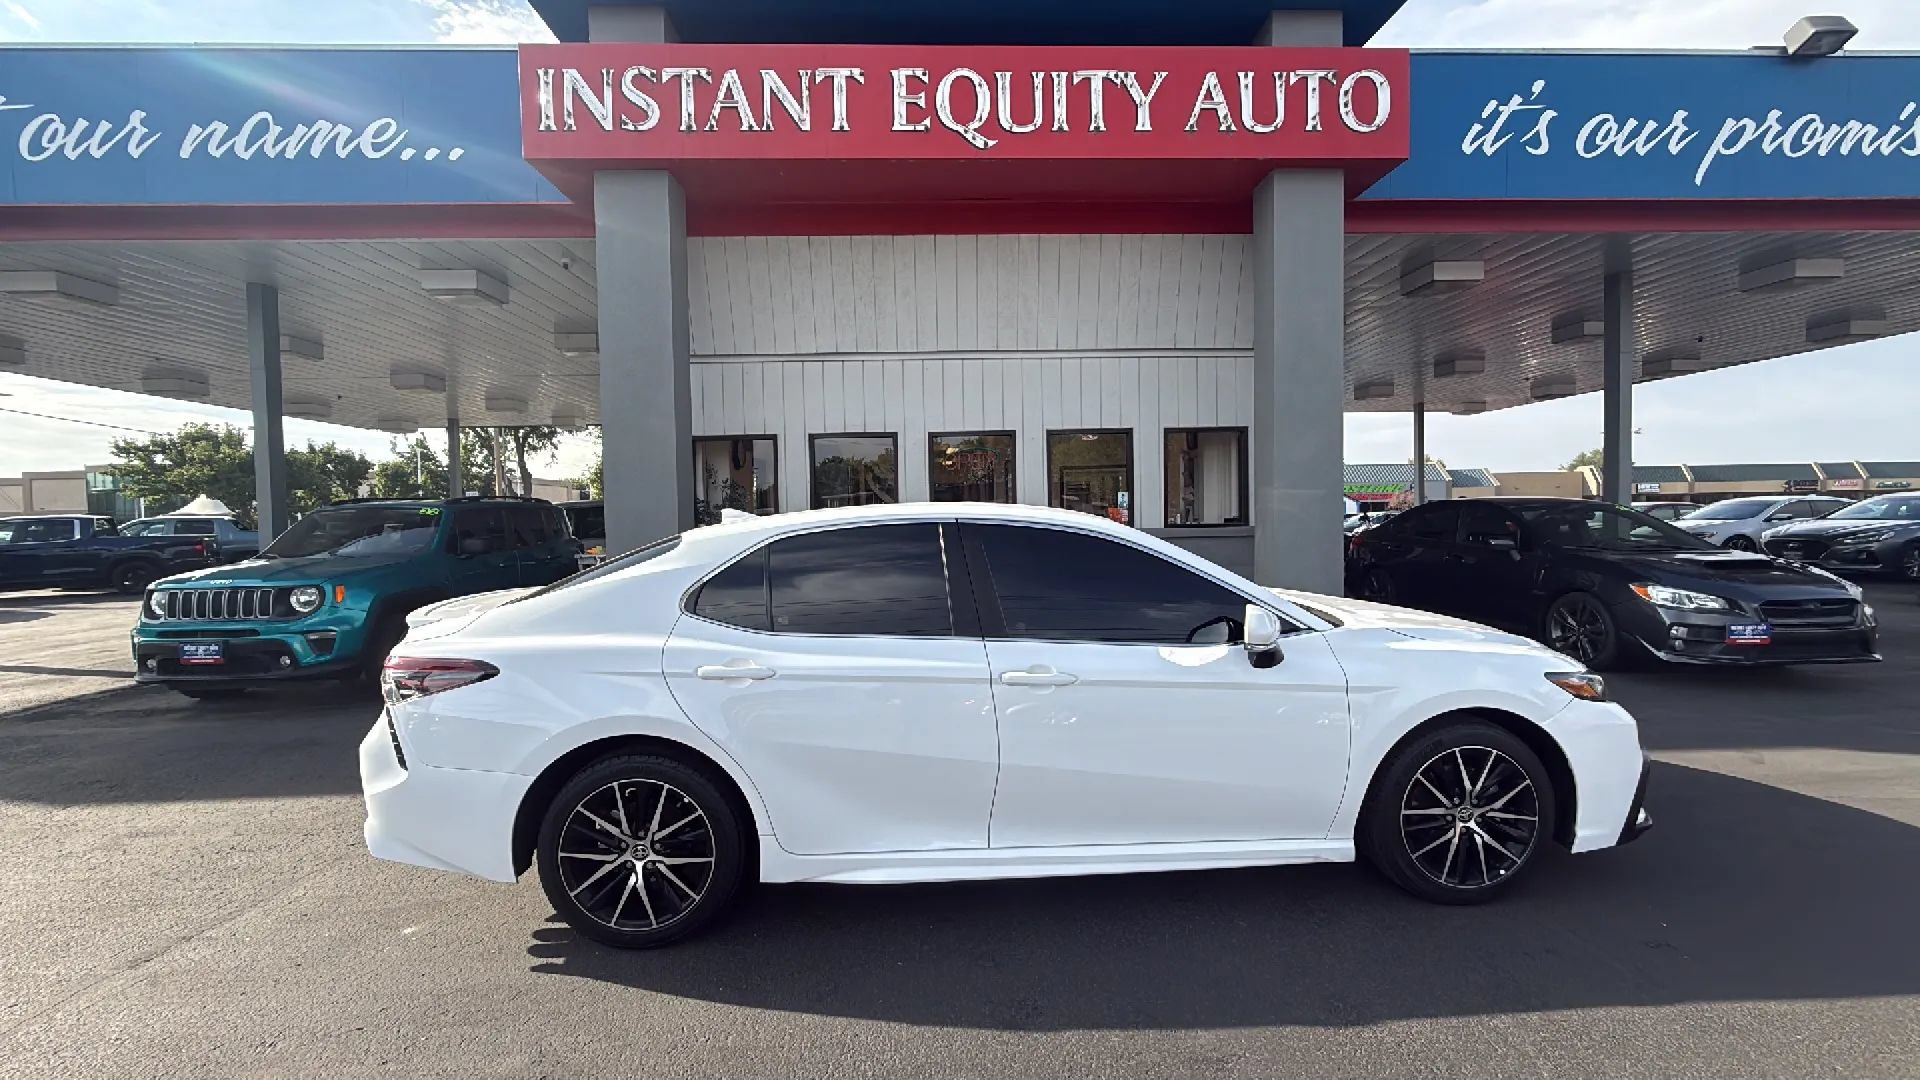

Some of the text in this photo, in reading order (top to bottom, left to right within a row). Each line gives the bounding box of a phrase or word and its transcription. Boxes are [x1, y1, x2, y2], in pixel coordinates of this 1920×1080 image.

[18, 110, 466, 161] our name...
[536, 65, 1391, 149] INSTANT EQUITY AUTO
[1461, 79, 1558, 157] it's
[1575, 109, 1699, 158] our
